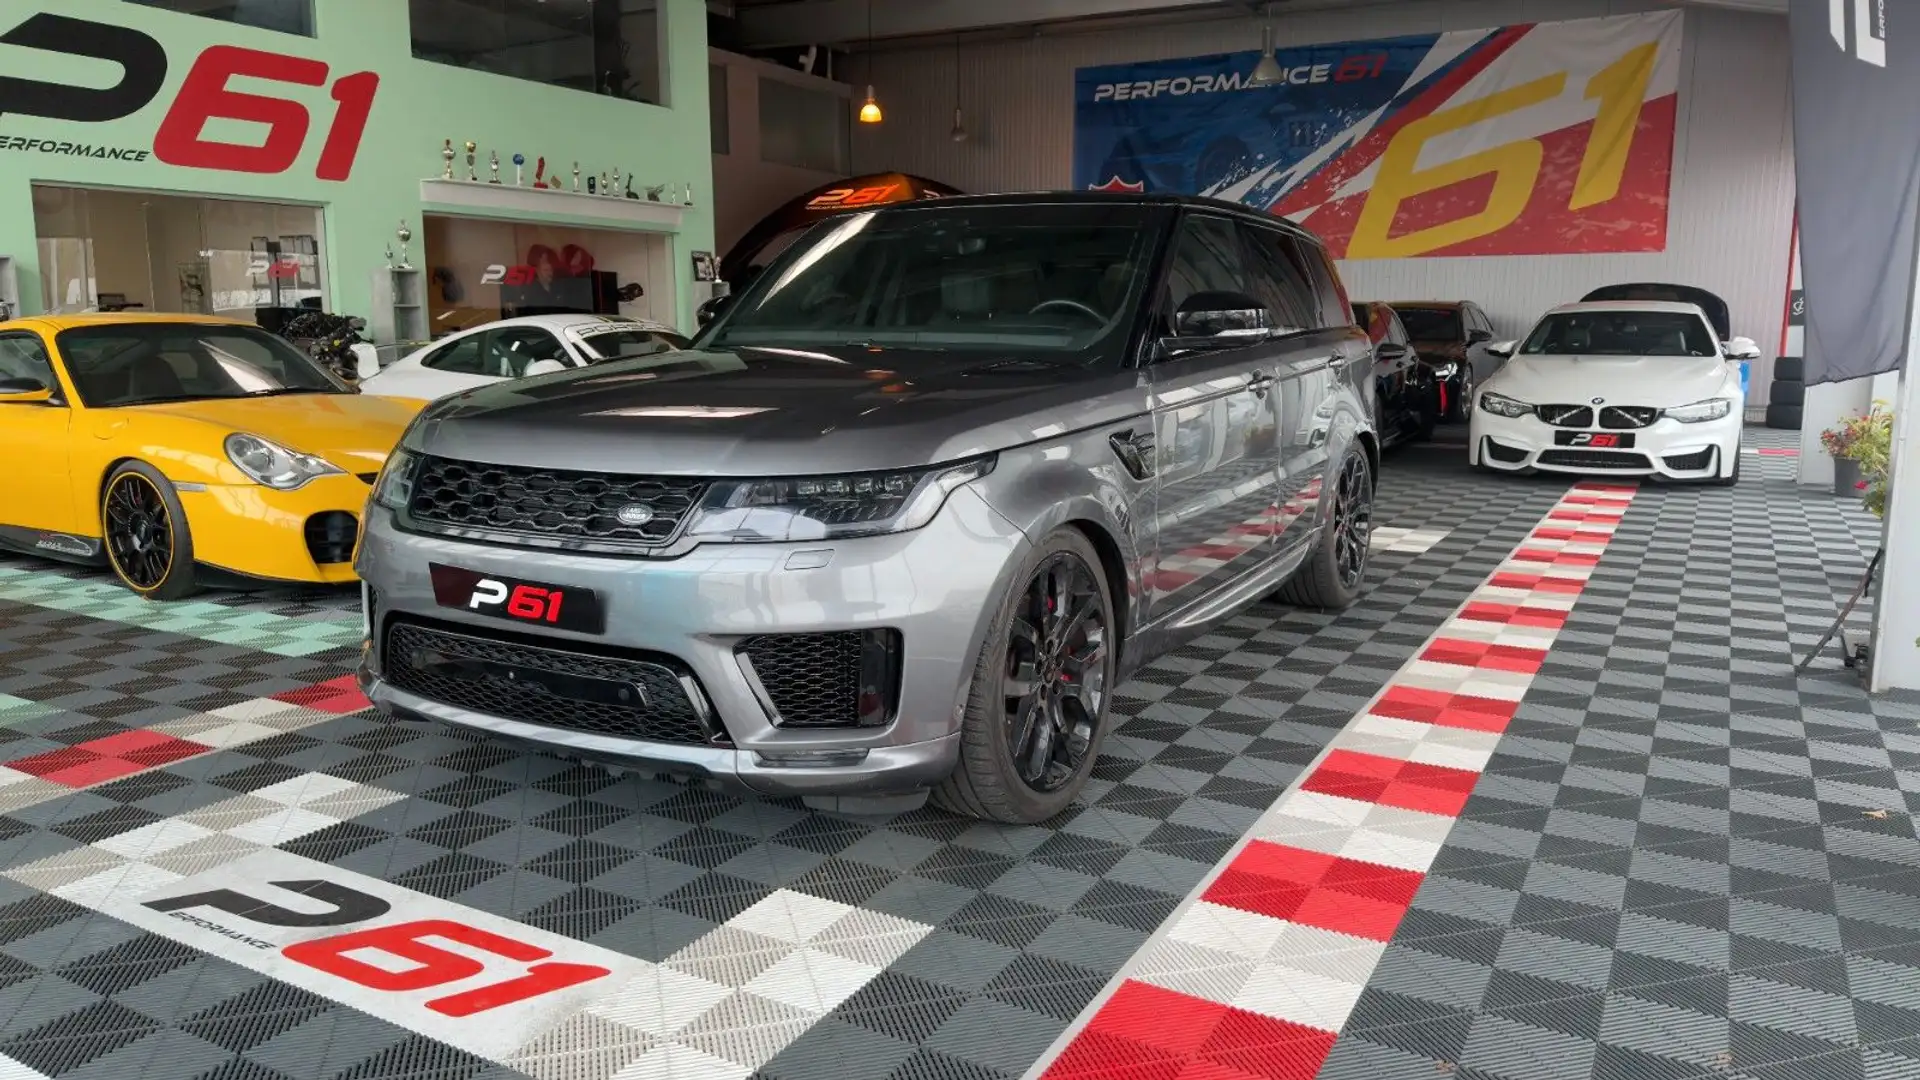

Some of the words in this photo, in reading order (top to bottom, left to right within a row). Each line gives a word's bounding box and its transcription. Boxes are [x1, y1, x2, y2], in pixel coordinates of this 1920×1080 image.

[1334, 52, 1390, 84] 61
[0, 12, 380, 182] P61
[1345, 40, 1660, 260] 61
[480, 263, 537, 287] P61
[576, 323, 676, 337] PORSC
[1569, 433, 1620, 448] P61
[469, 578, 564, 623] P61
[140, 879, 612, 1018] P61
